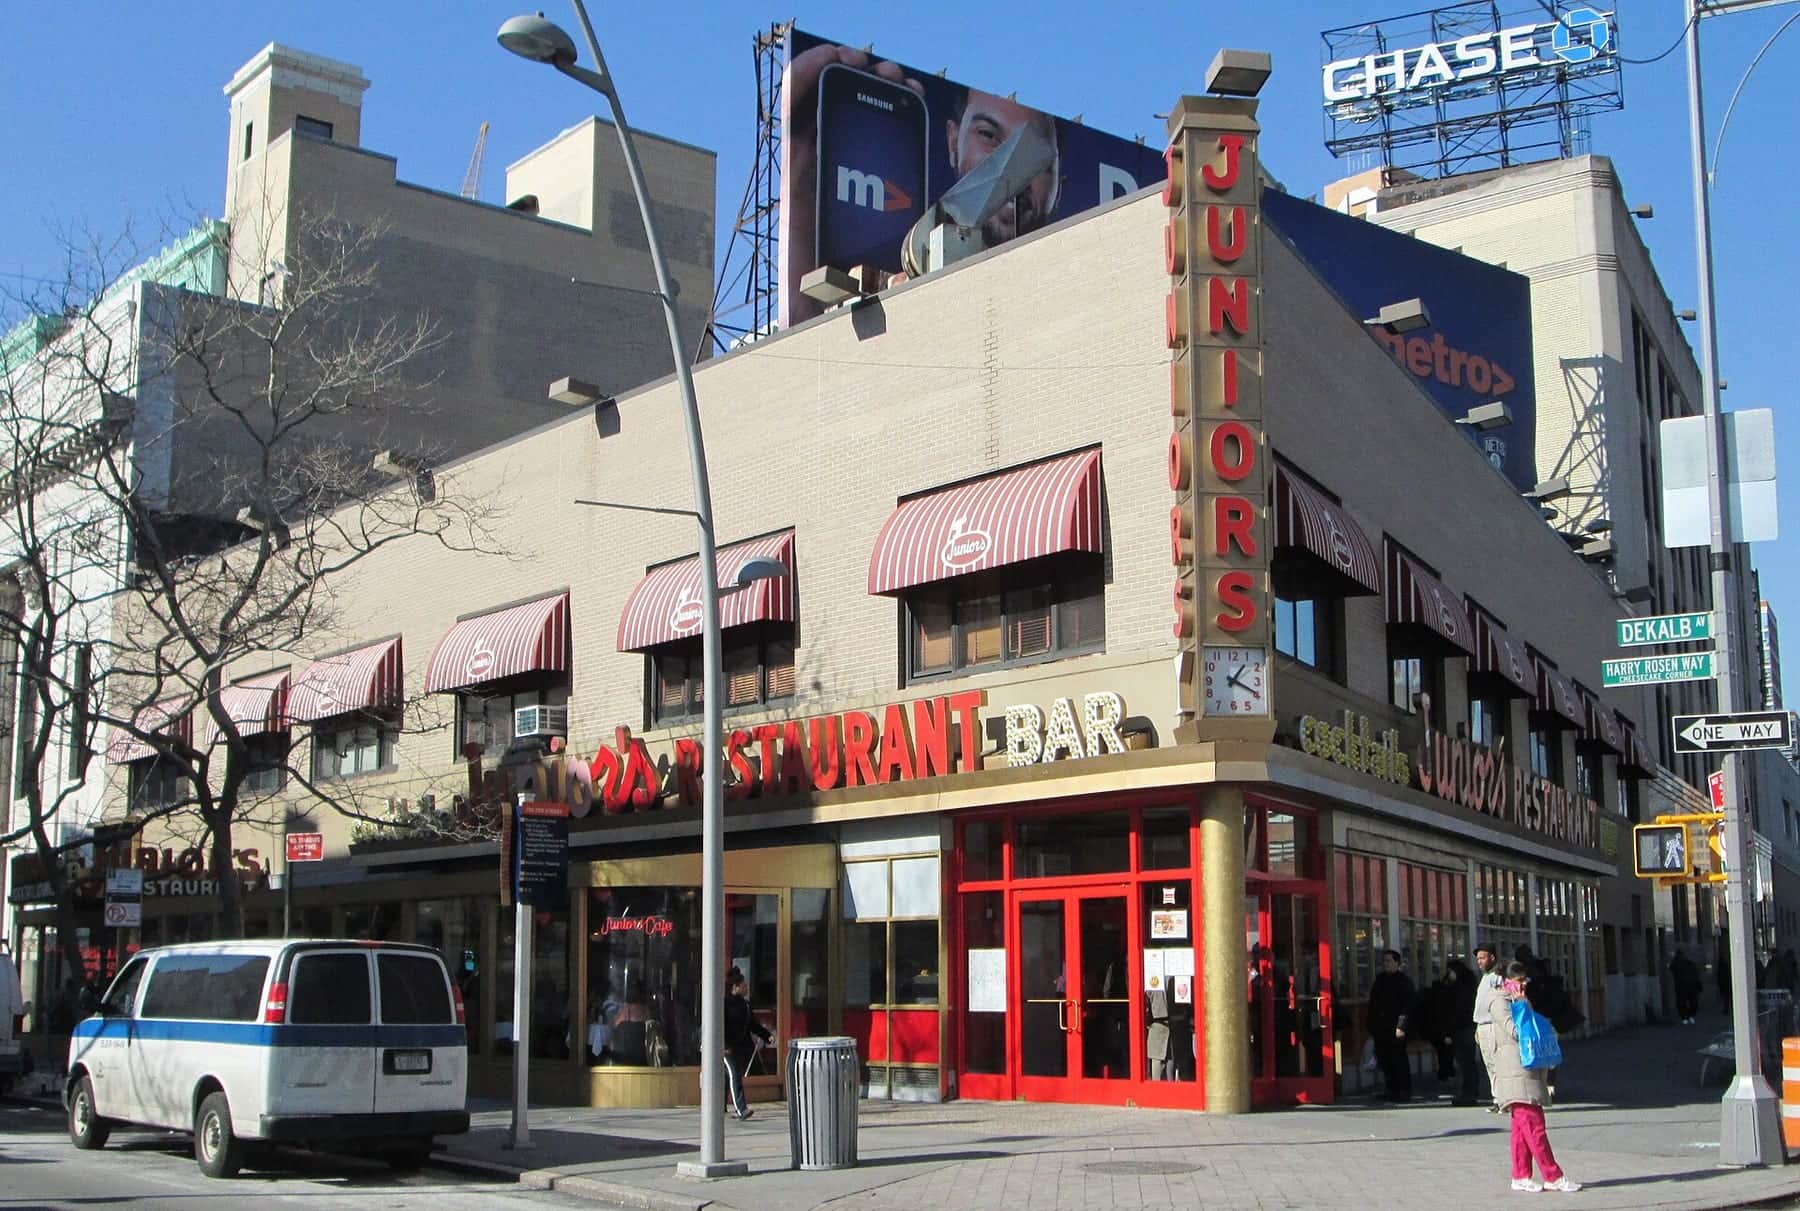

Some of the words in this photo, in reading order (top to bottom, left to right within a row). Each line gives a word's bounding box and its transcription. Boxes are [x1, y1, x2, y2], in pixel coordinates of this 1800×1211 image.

[1322, 24, 1541, 101] CHASE
[857, 92, 894, 112] SAMSUNG
[1200, 134, 1257, 633] JUNIORS
[1622, 618, 1692, 643] DEKALB
[1695, 616, 1705, 628] AV
[1606, 660, 1640, 677] HARRY
[1645, 658, 1679, 674] ROSEN
[1682, 655, 1704, 671] WAY
[1619, 673, 1661, 683] CHEESECAKE
[1665, 670, 1694, 680] CORNER
[1692, 726, 1723, 740] ONE
[1740, 724, 1773, 738] WAY
[676, 689, 983, 806] RSTAURANT
[1006, 691, 1127, 768] BAR
[1513, 766, 1598, 849] RESTAURANT
